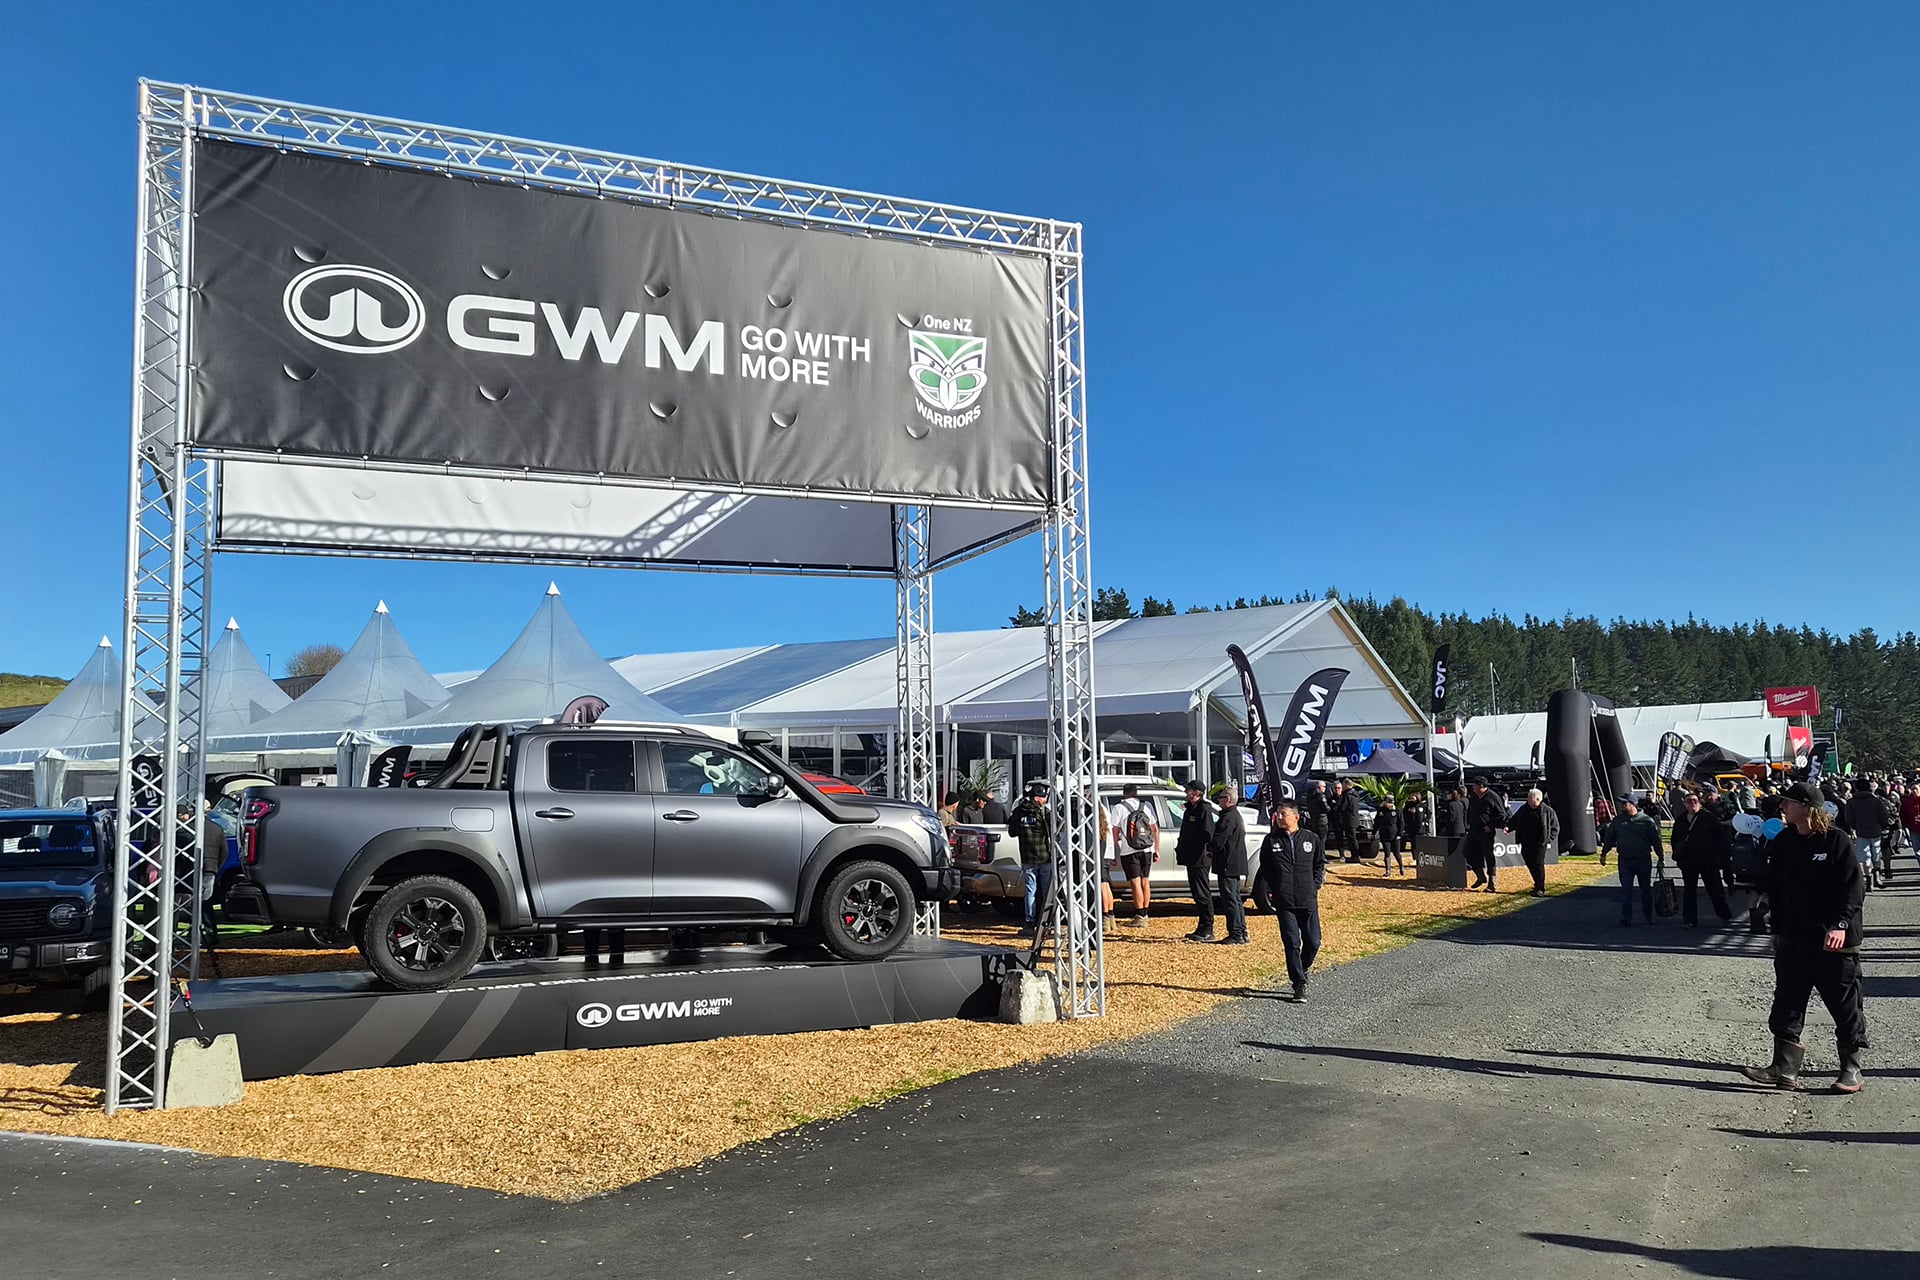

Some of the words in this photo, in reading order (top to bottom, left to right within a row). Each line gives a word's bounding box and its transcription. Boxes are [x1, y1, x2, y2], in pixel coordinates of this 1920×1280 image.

[447, 294, 725, 376] GWM
[923, 314, 951, 330] One
[953, 317, 972, 332] NZ
[741, 324, 788, 353] GO
[793, 330, 871, 362] WITH
[741, 353, 830, 386] MORE
[914, 396, 982, 429] WARRIORS
[1434, 660, 1447, 699] JAC
[1282, 683, 1330, 778] GWM
[377, 757, 397, 788] WM
[615, 1000, 691, 1022] GWM
[693, 999, 709, 1008] GO
[709, 997, 733, 1008] WITH
[693, 1006, 721, 1017] MORE
